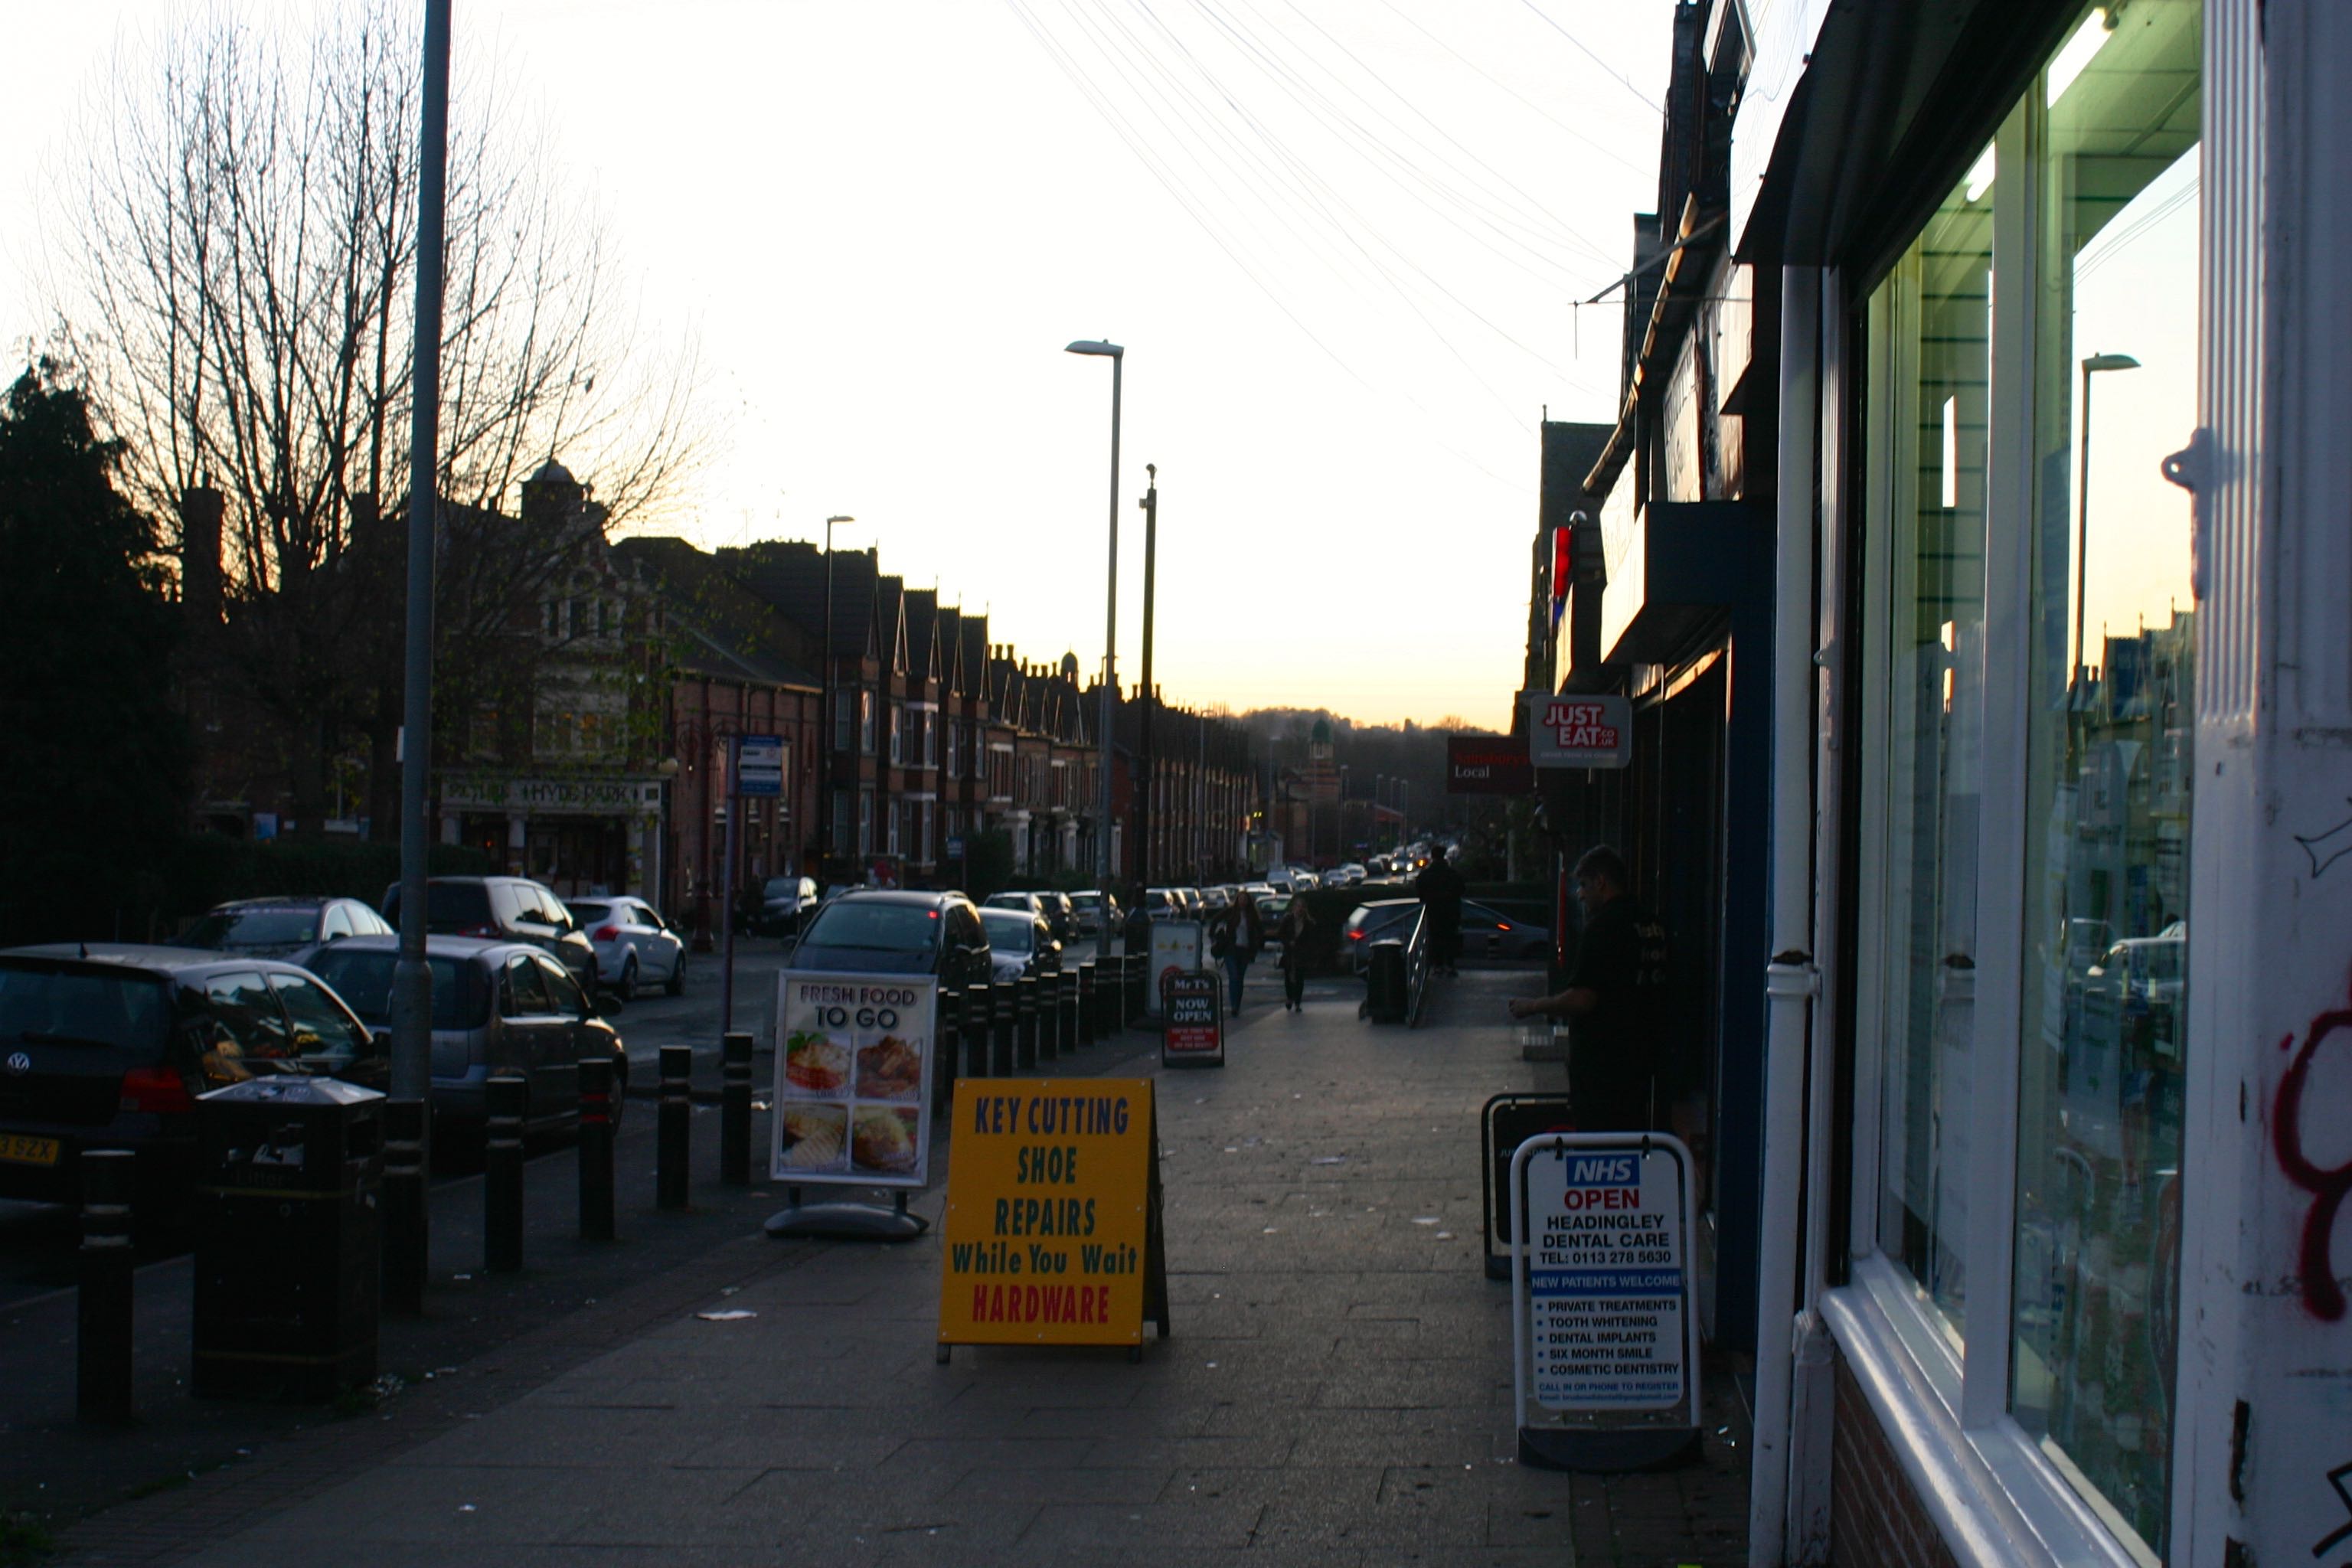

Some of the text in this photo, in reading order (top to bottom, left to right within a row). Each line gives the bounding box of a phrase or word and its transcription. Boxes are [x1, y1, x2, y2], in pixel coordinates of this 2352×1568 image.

[1546, 705, 1602, 726] JUST
[1560, 727, 1599, 746] EAT
[1455, 765, 1490, 779] Local
[801, 985, 914, 1005] FRESH FOOD
[1176, 998, 1209, 1010] NOW
[815, 1007, 897, 1028] TO GO
[1173, 1011, 1212, 1022] OPEN
[975, 1096, 1129, 1135] KEY CUTTING
[1017, 1147, 1076, 1184] SHOE
[1573, 1158, 1633, 1182] NHS
[1564, 1189, 1639, 1210] OPEN
[995, 1198, 1096, 1236] REPAIRS
[1547, 1215, 1664, 1230] HEADINGLEY
[1544, 1233, 1670, 1248] DENTAL CARE
[952, 1242, 1137, 1274] While You Wait
[1540, 1251, 1671, 1264] TEL: 0113 278 5630
[1532, 1274, 1681, 1289] NEW PATIENTS WELCOME
[972, 1284, 1109, 1324] HARDWARE
[1548, 1300, 1677, 1312] PRIVATE TREATMENTS
[1549, 1316, 1658, 1328] TOOTH WHITENING
[1549, 1332, 1657, 1344] DENTAL IMPLANTS
[1549, 1348, 1654, 1359] SIX MONTH SMILE
[1550, 1363, 1679, 1375] COSMETIC DENTISTRY
[1589, 1383, 1619, 1391] PHONE
